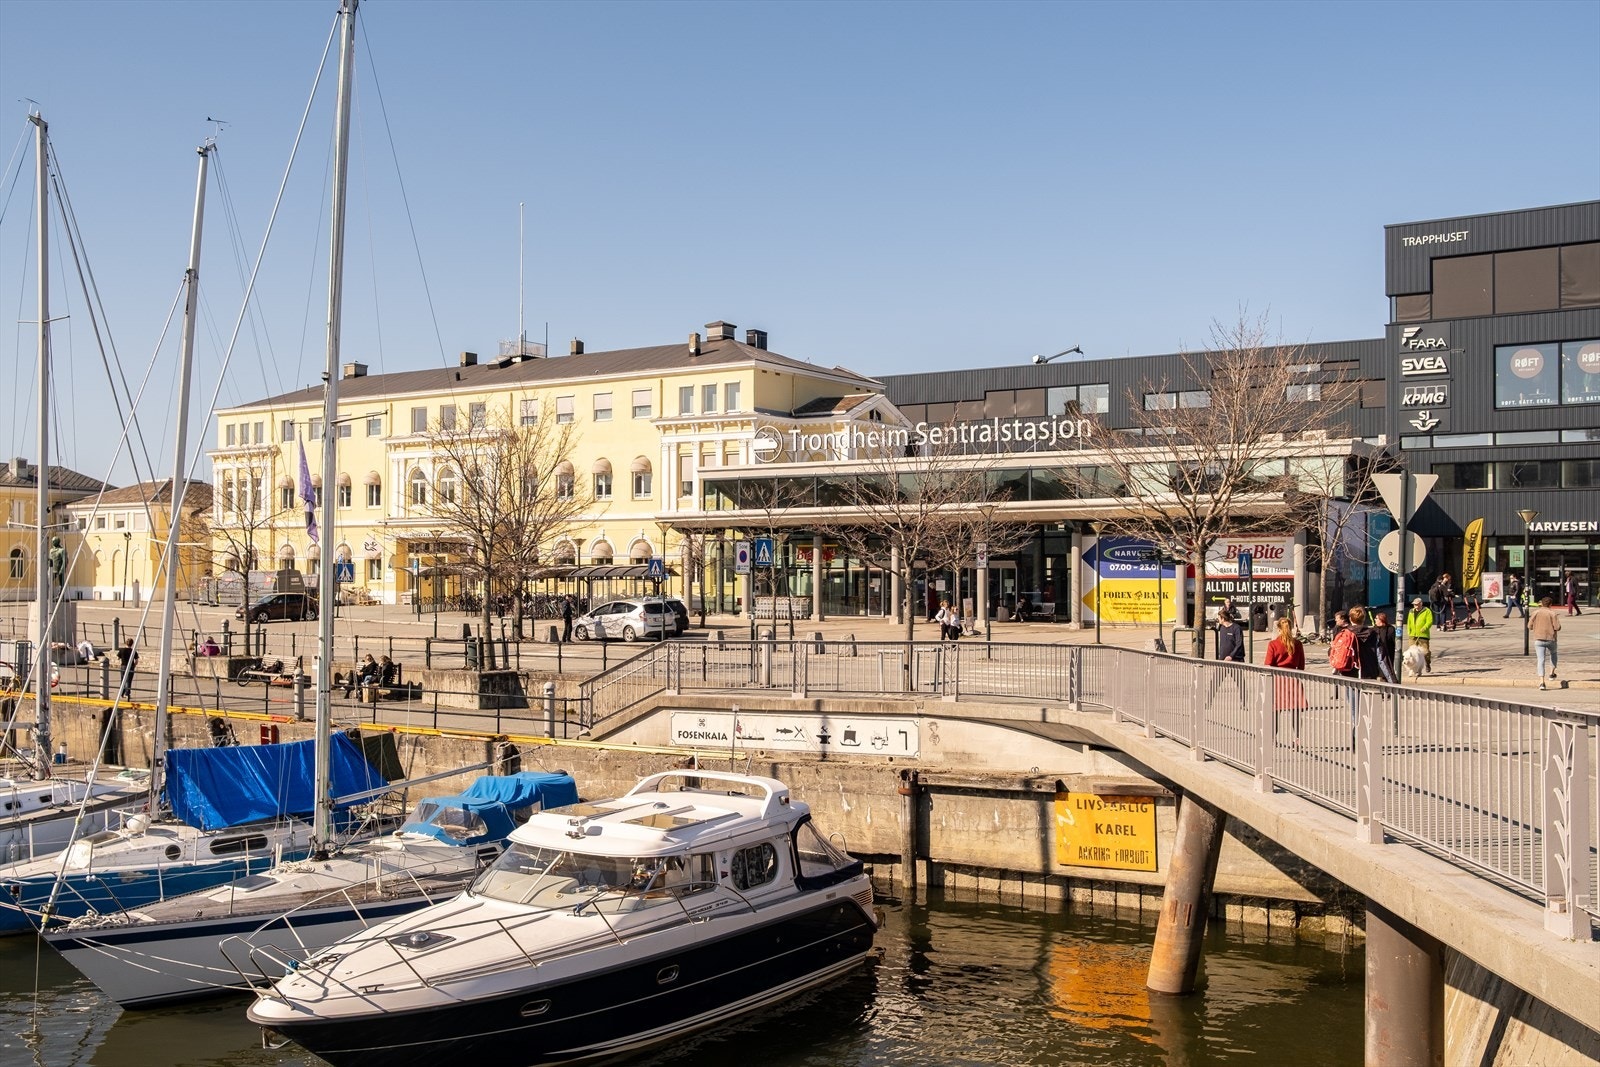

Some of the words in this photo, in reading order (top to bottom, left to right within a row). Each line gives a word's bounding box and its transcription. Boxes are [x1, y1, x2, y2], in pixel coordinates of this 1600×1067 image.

[1402, 230, 1469, 246] TRAPPHUSET
[1409, 337, 1447, 349] FARA
[1401, 356, 1446, 370] SVEA
[1514, 357, 1540, 368] RØFT
[1582, 352, 1600, 363] RØF
[1402, 392, 1445, 405] KPMG
[1418, 410, 1430, 420] SJ
[788, 421, 908, 452] Trondheim
[915, 414, 1092, 446] Sentralstasjon
[1109, 563, 1132, 571] 07.00
[1205, 581, 1235, 592] ALLTID
[1260, 581, 1291, 593] PRISER
[1103, 591, 1132, 599] FOREX
[1143, 591, 1169, 599] BANK
[1230, 595, 1256, 603] P-HOTES
[678, 730, 728, 740] FOSENKAIA
